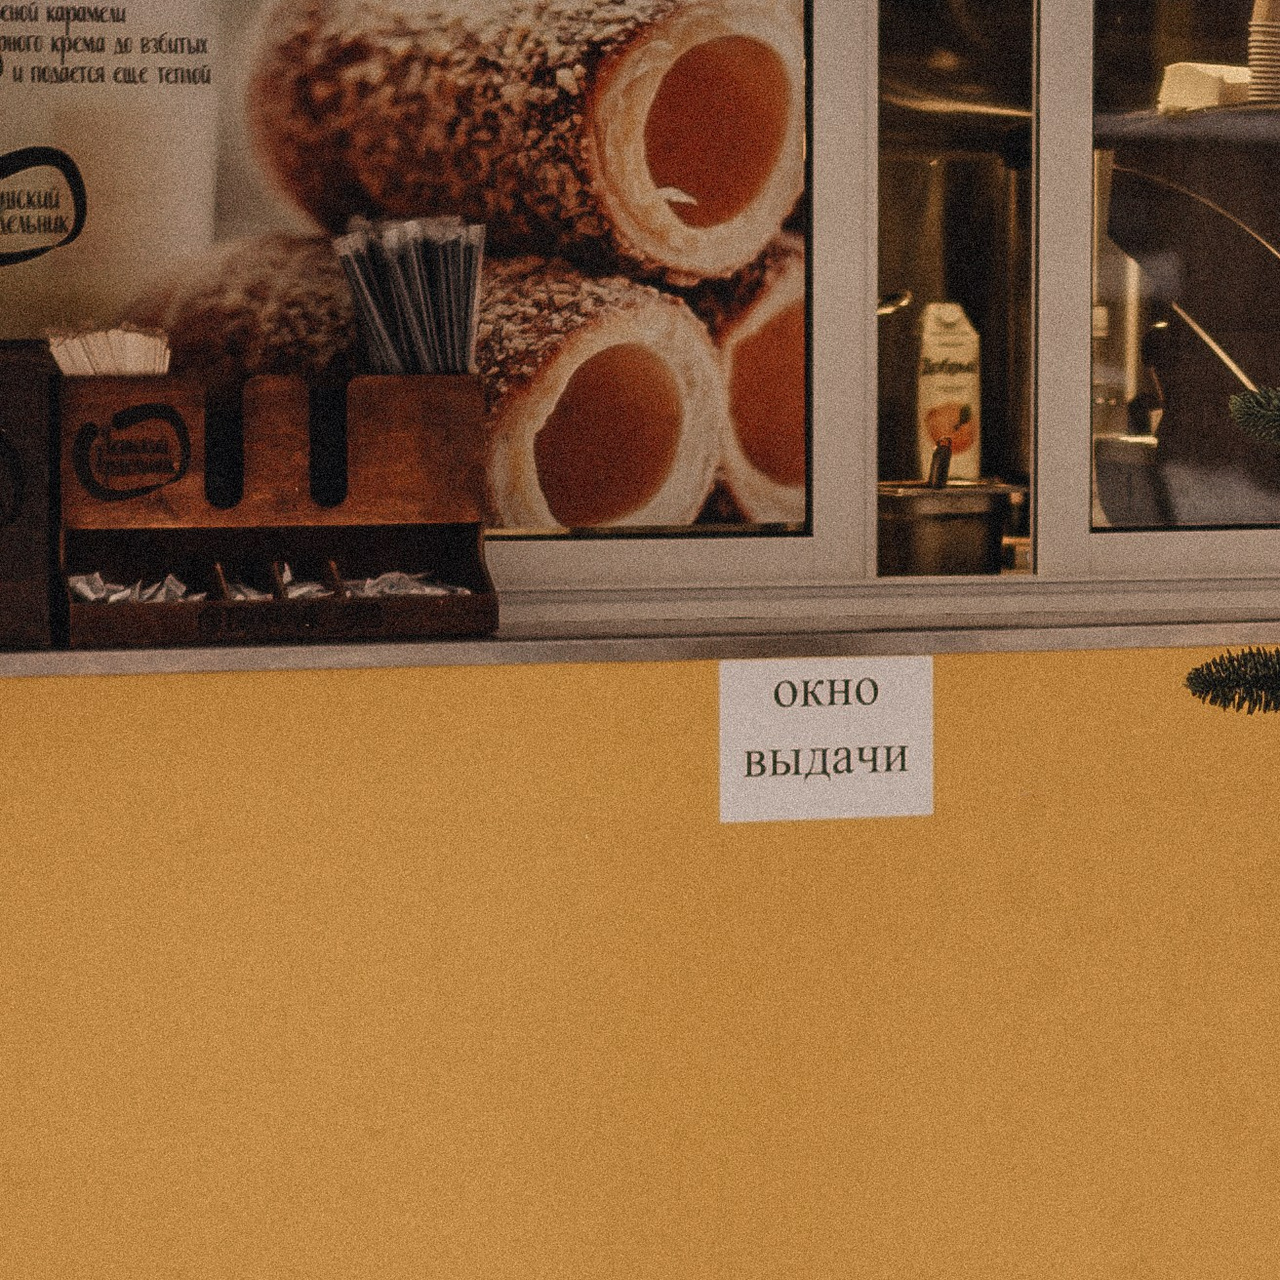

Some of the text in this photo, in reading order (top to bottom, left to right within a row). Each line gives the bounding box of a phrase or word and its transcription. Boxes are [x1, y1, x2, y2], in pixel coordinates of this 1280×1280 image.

[47, 5, 127, 37] карамели
[51, 36, 106, 65] крема
[114, 37, 133, 56] до
[140, 32, 209, 55] взбитых
[13, 64, 211, 86] и подается еще теплой
[773, 676, 879, 708] окно
[744, 745, 909, 782] выдачи
